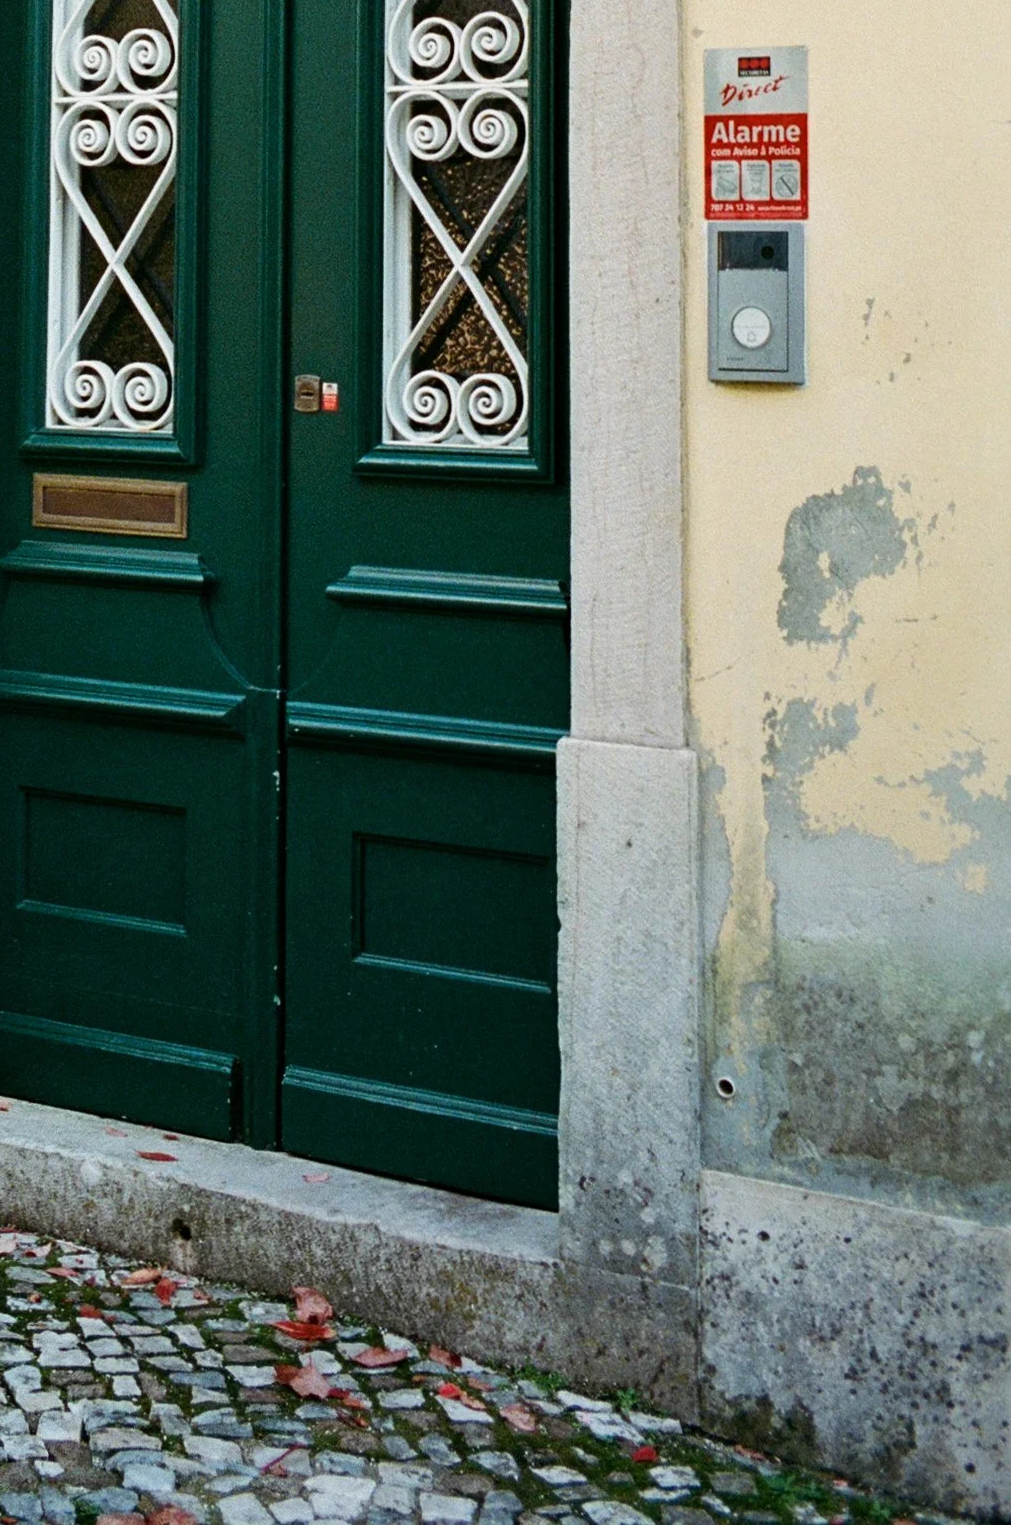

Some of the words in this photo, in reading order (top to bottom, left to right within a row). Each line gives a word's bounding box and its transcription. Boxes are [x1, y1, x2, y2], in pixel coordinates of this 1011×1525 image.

[721, 76, 789, 106] Direct
[711, 120, 801, 143] Alarme
[711, 148, 731, 157] com
[733, 145, 758, 156] Aviso
